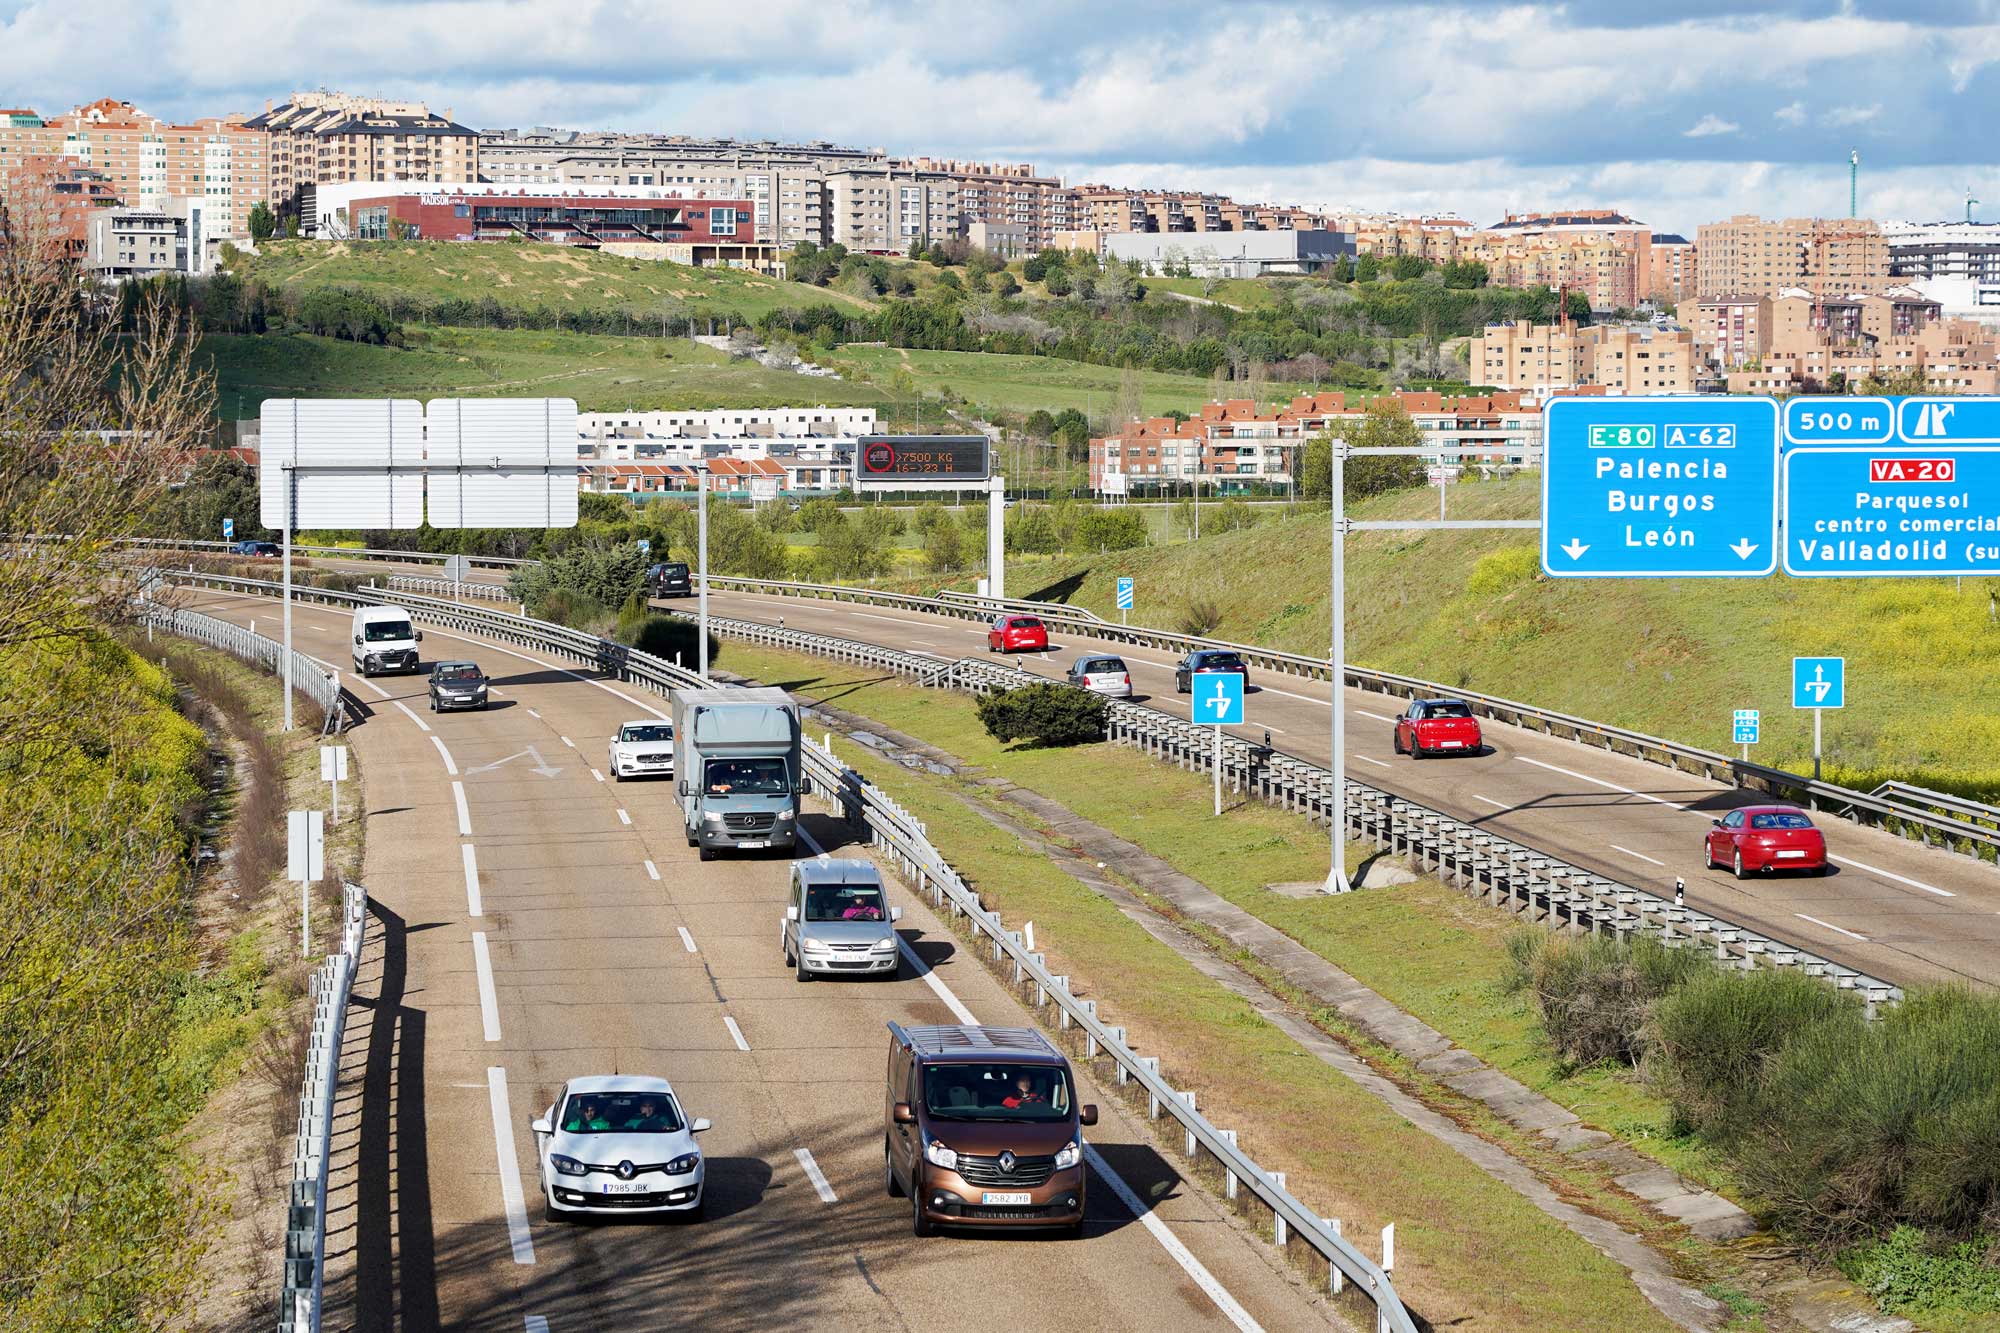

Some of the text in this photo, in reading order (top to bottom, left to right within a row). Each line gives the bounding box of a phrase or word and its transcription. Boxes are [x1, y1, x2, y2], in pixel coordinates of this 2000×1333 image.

[421, 195, 449, 206] MADISON
[1801, 413, 1880, 430] 500 m
[1592, 428, 1732, 445] E-80 A-62
[938, 453, 953, 462] KG
[946, 464, 953, 473] H
[1596, 458, 1727, 479] Palencia
[1874, 462, 1951, 479] VA-20
[1608, 490, 1714, 518] Burgos
[1856, 493, 1968, 512] Parquesol
[1815, 517, 1887, 532] centro
[1626, 525, 1694, 547] León
[1799, 540, 1947, 561] Valladolid
[609, 1184, 648, 1192] 7985 JBK
[989, 1194, 1029, 1203] 2582 JYB
